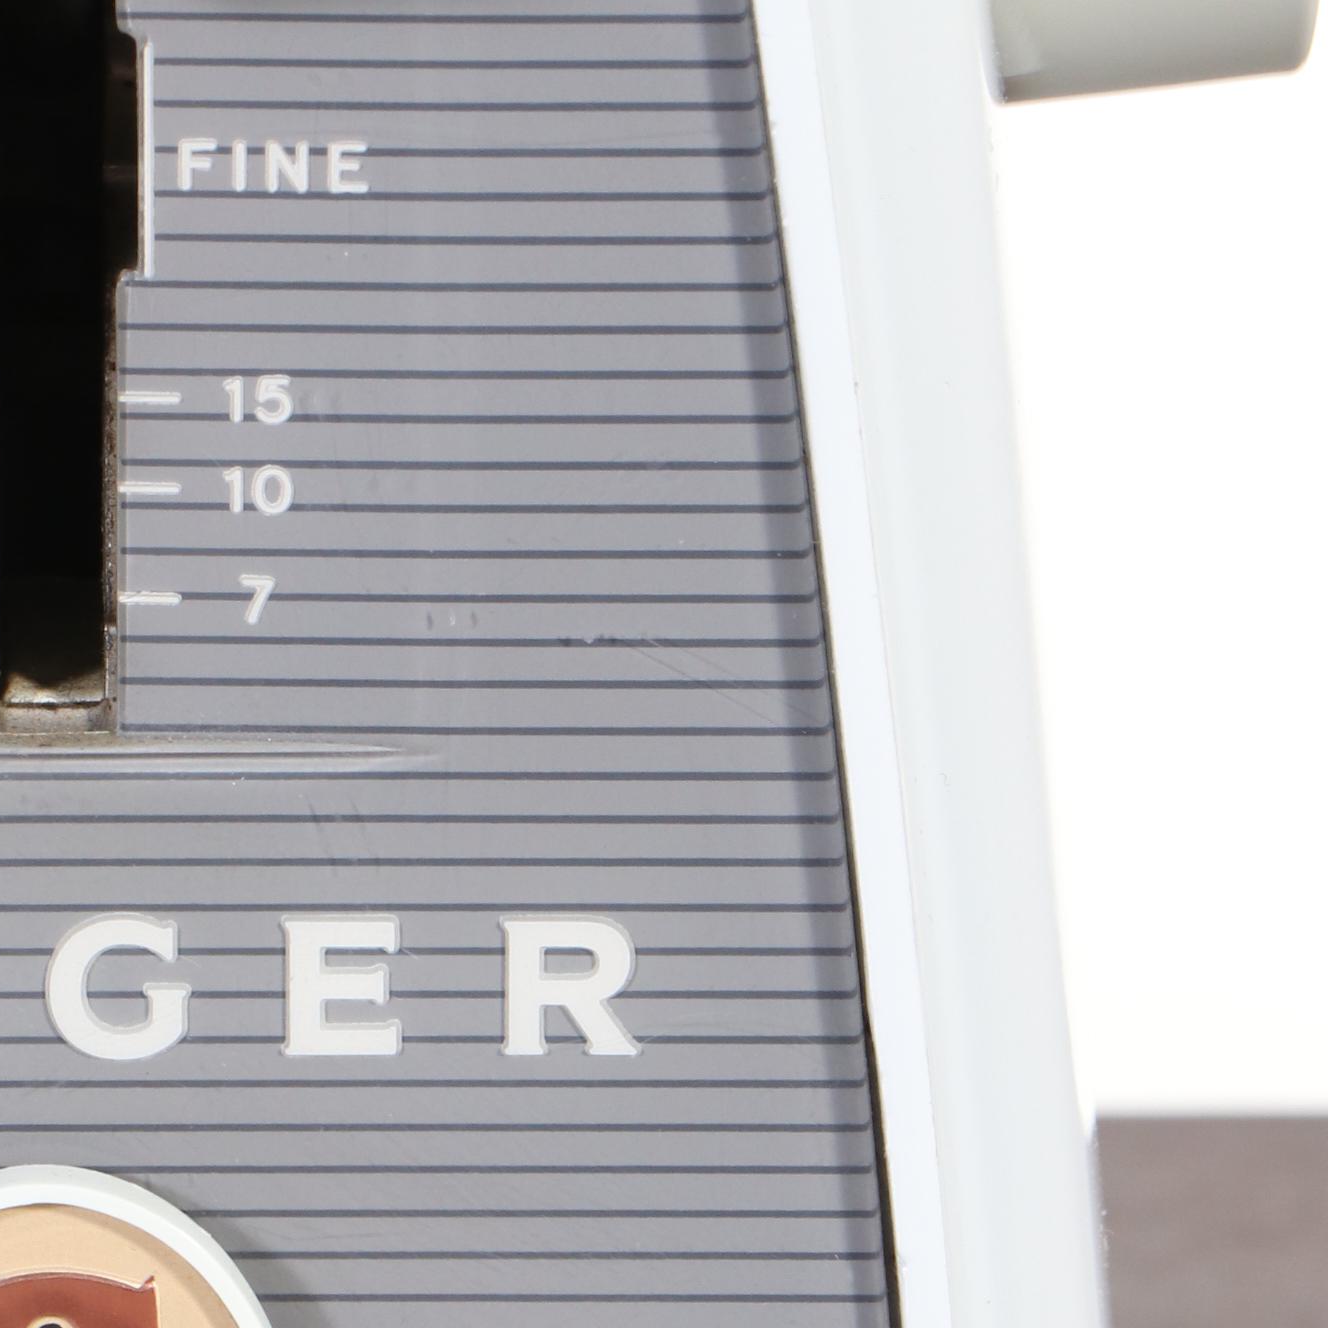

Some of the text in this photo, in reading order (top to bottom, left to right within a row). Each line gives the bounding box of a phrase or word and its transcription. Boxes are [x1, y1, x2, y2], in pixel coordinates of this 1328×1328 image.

[177, 137, 369, 193] FINE
[222, 374, 294, 425] 15
[222, 464, 294, 517] 10
[238, 573, 276, 625] 7
